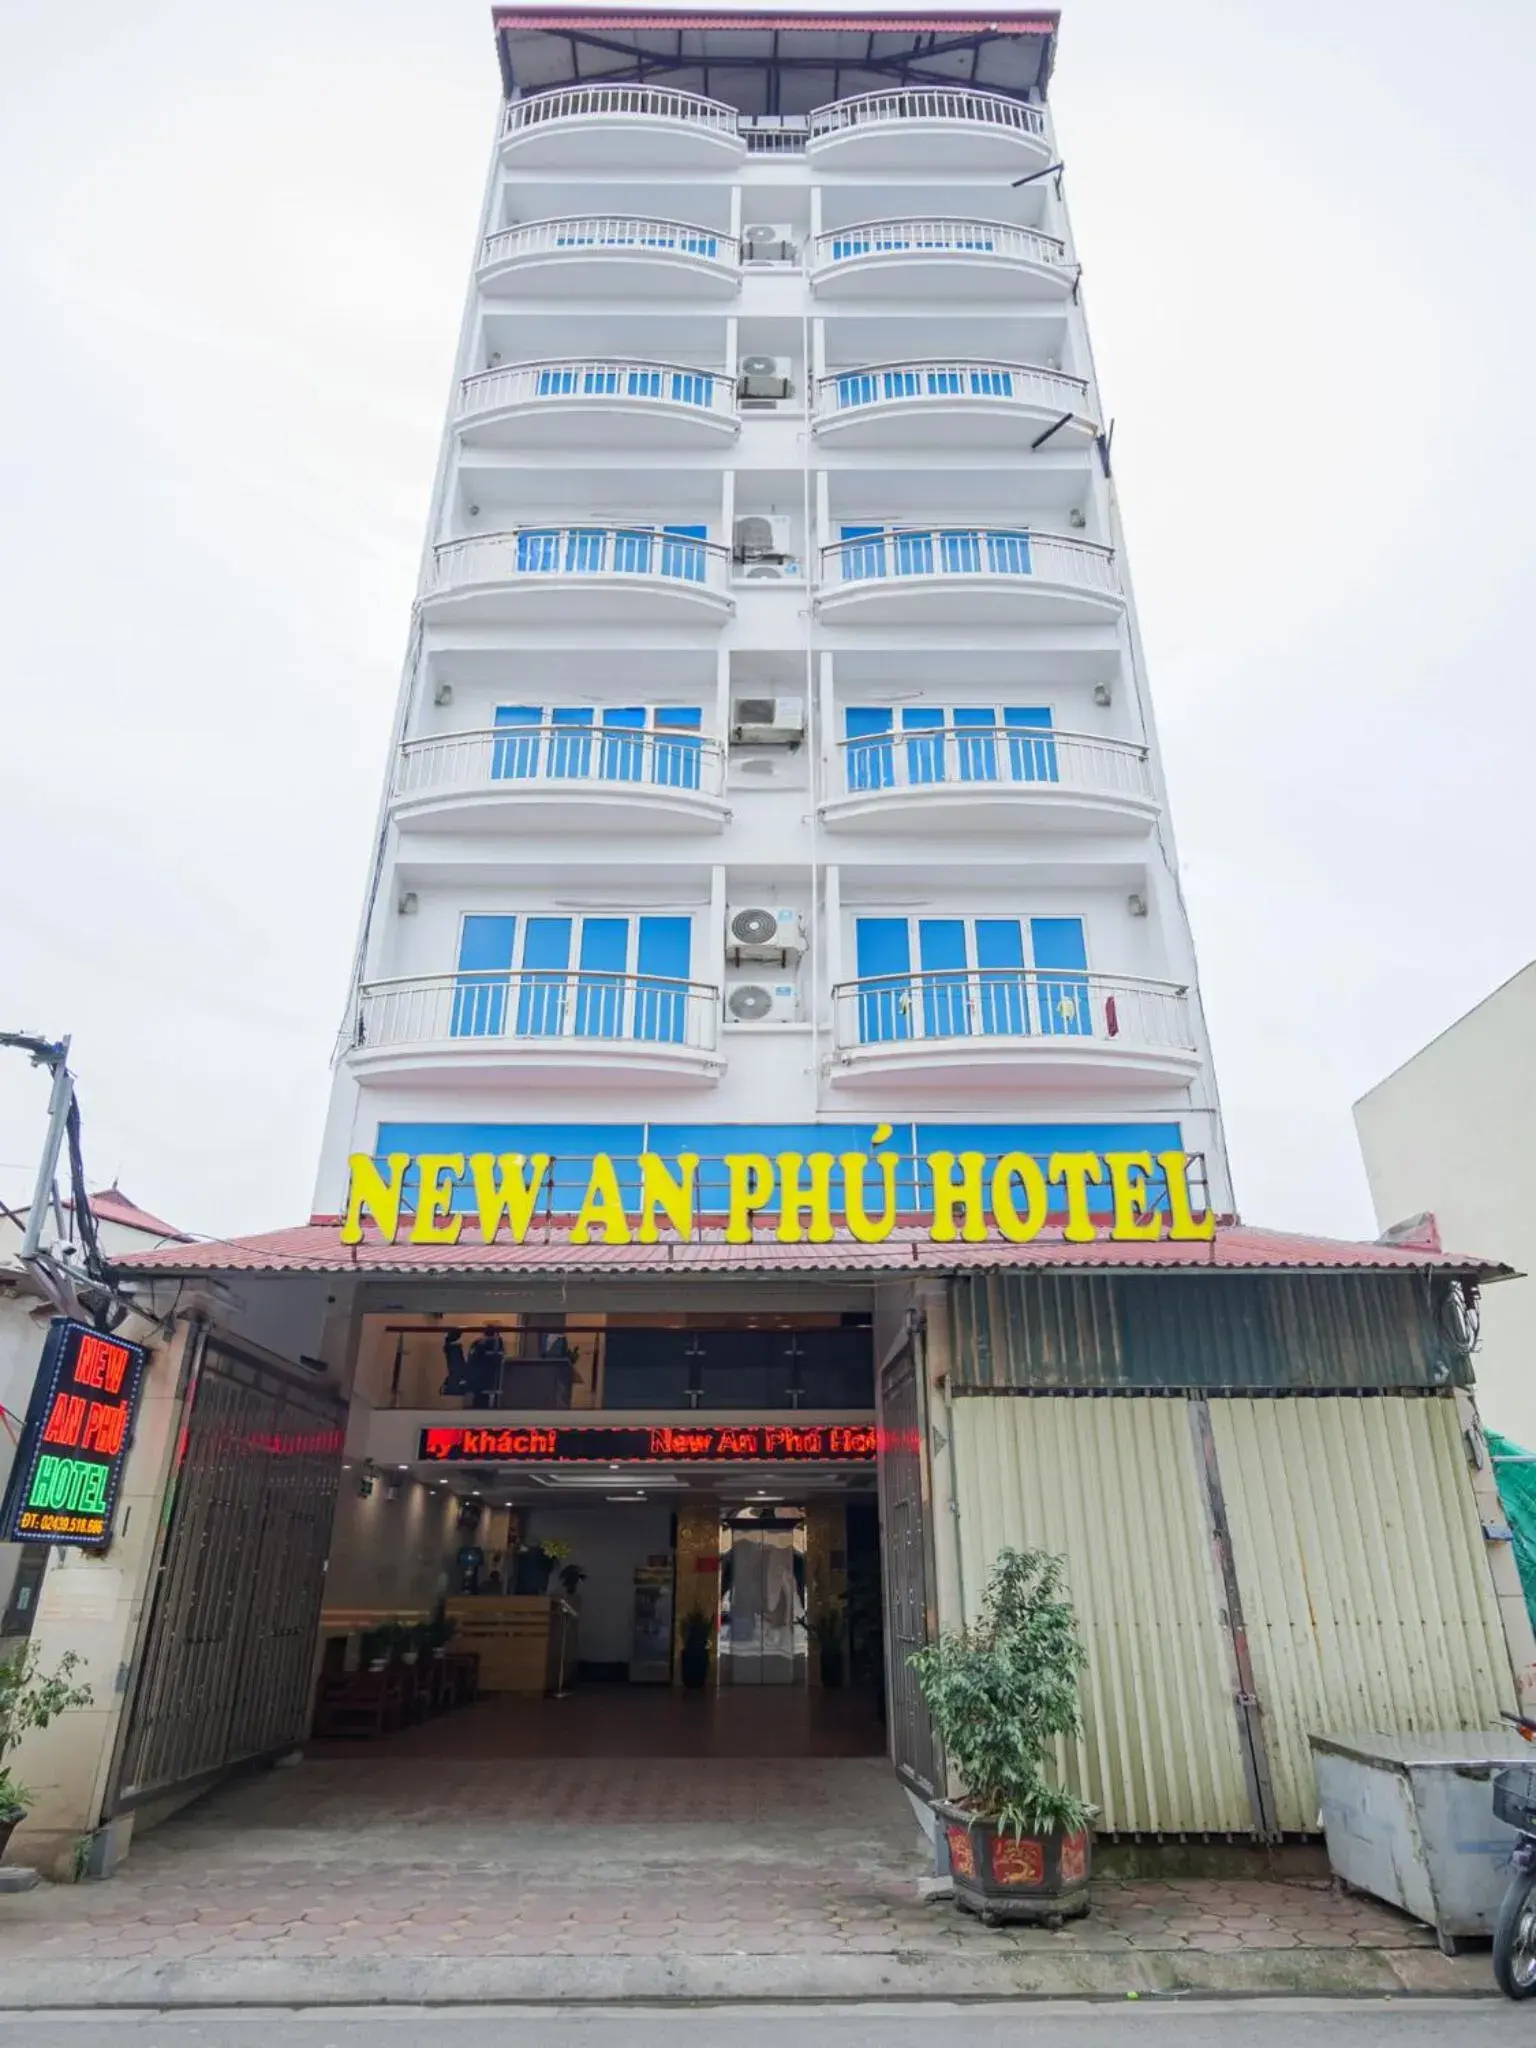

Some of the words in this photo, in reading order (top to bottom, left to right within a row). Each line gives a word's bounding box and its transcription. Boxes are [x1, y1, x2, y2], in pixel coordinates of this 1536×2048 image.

[340, 1152, 551, 1245] NEW
[569, 1152, 700, 1245] AN
[724, 1122, 900, 1244] PHÚ
[926, 1150, 1216, 1243] HOTEL
[74, 1335, 130, 1395] NEW
[43, 1392, 86, 1447] AN
[81, 1400, 129, 1456] PHÚ
[463, 1429, 557, 1454] khách!
[650, 1428, 713, 1453] New
[716, 1429, 757, 1453] An
[29, 1455, 110, 1514] HOTEL
